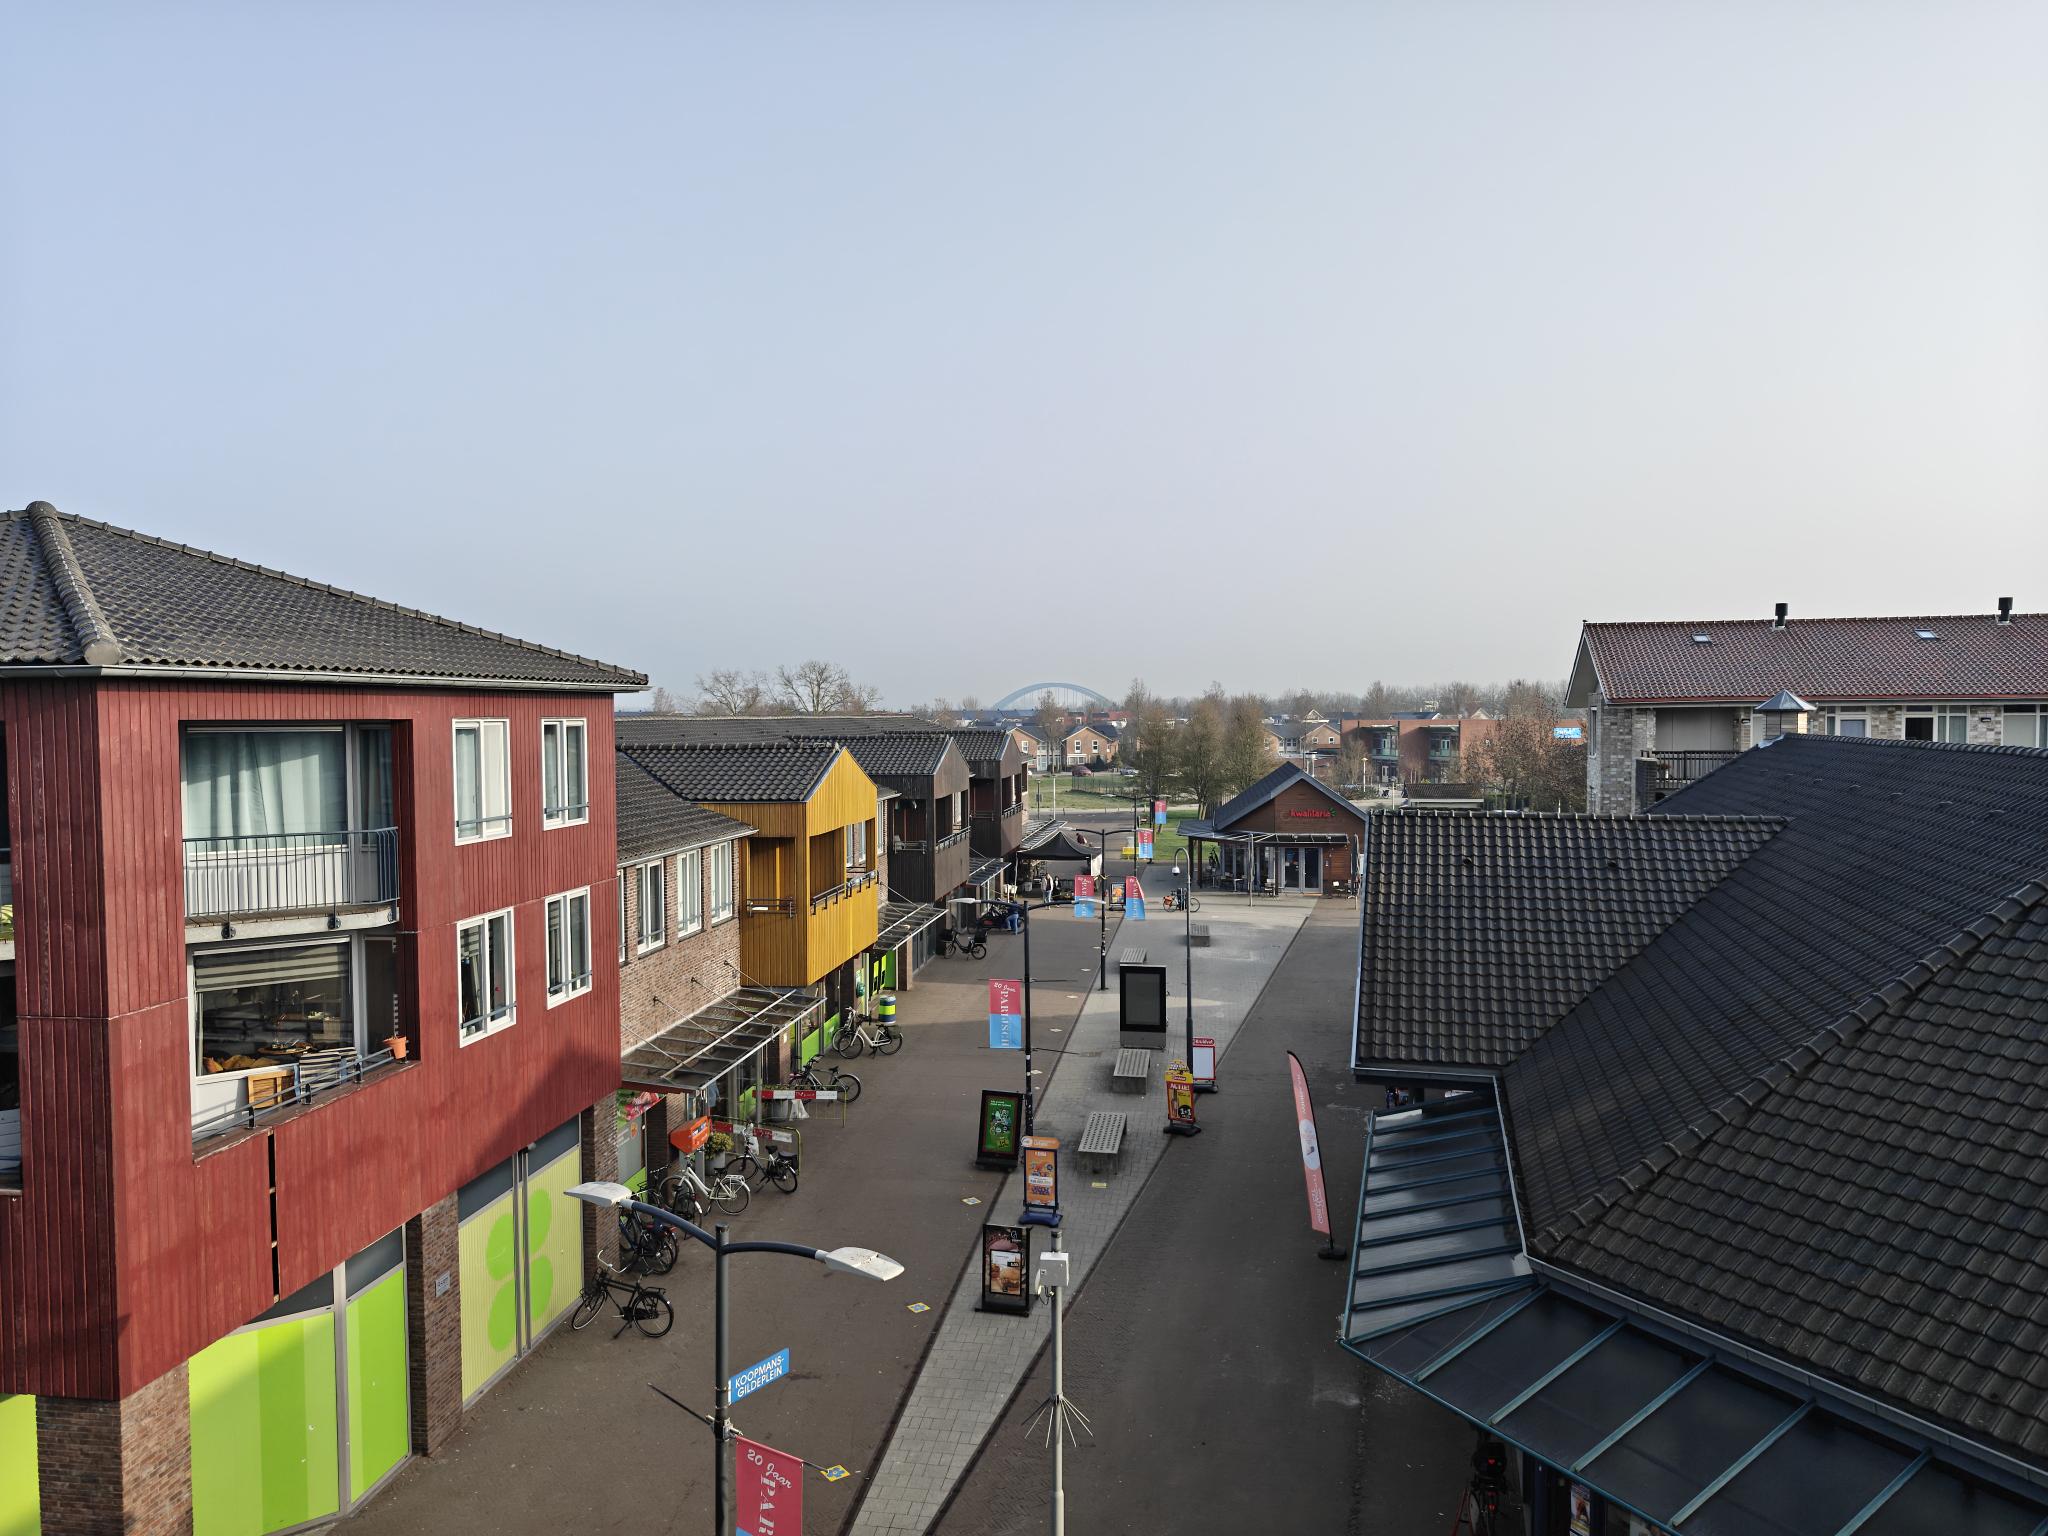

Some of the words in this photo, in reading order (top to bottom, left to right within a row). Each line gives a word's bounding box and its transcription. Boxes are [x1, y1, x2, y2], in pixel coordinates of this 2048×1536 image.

[735, 1355, 784, 1389] KOOPMANS-
[737, 1366, 782, 1398] GILDEPLEIN
[747, 1449, 763, 1466] 20
[766, 1462, 792, 1489] Jaar
